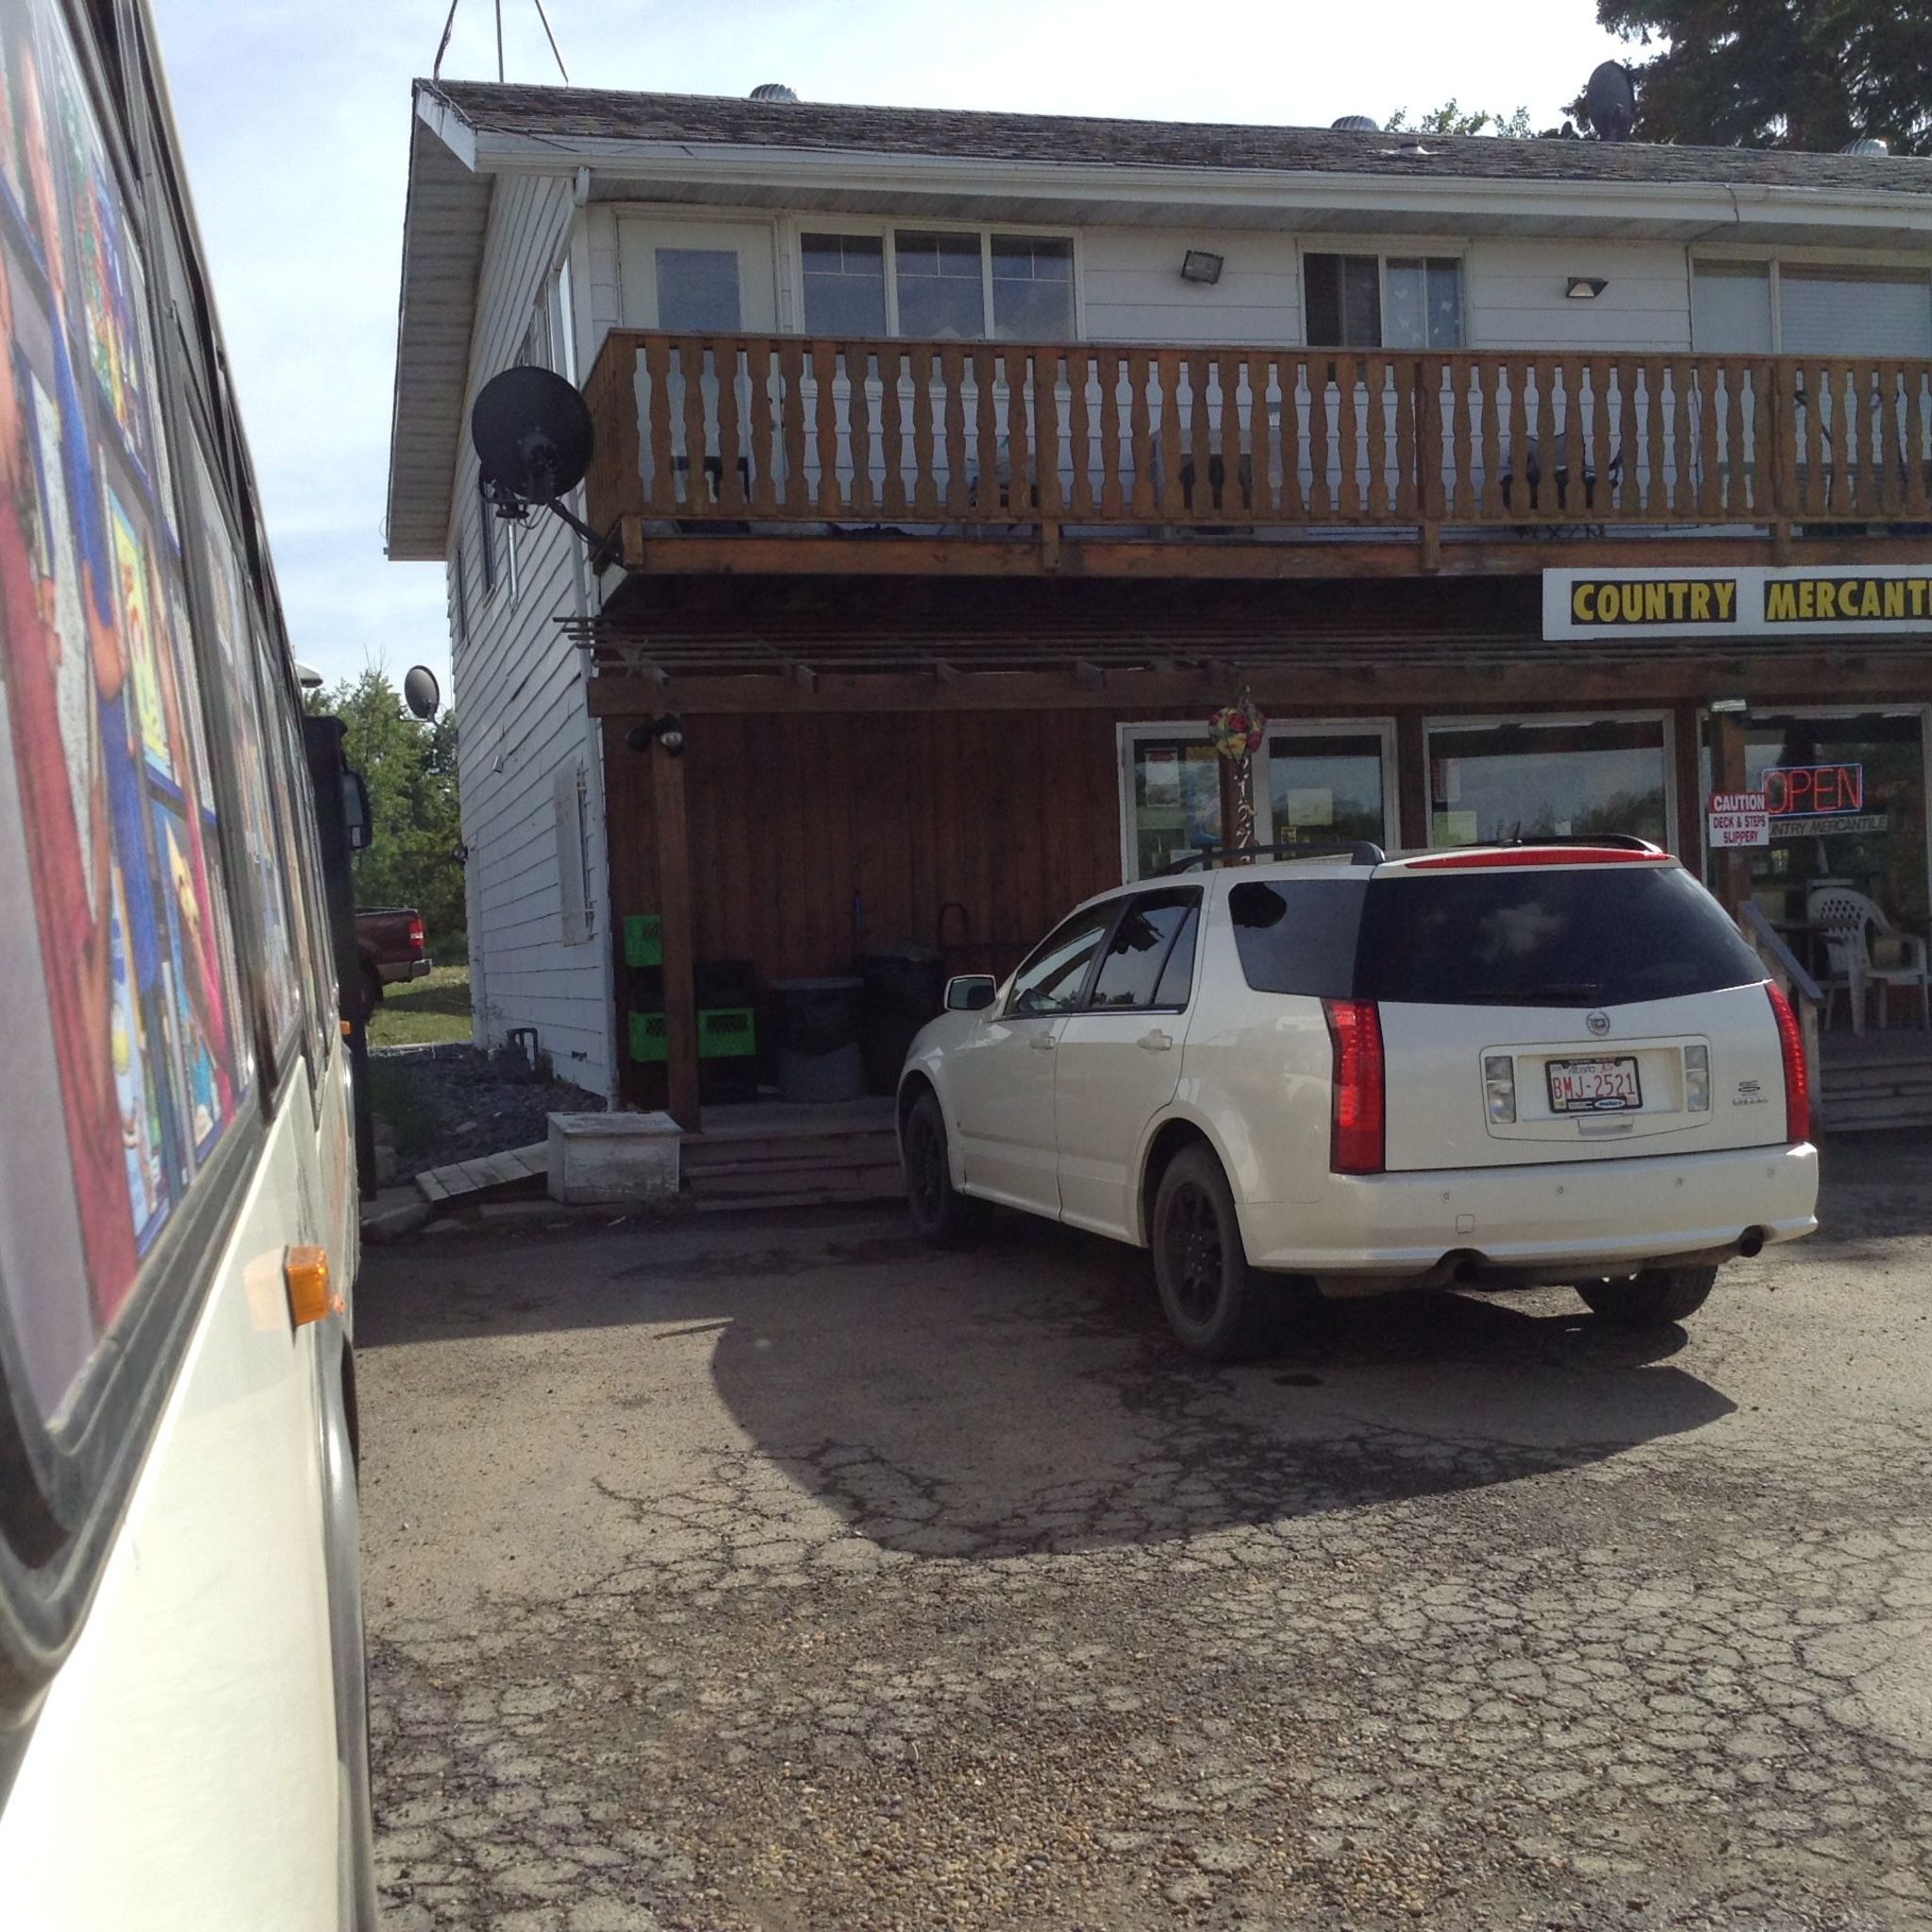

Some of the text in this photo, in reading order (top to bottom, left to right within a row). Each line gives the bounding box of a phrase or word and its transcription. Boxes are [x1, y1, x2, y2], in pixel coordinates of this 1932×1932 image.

[1573, 582, 1736, 622] COUNTRY
[1765, 767, 1860, 815] OPEN
[1713, 794, 1765, 811] CAUTION
[1713, 815, 1765, 828] DECK & STEPS
[1724, 830, 1758, 843] SLIPPERY
[1553, 1073, 1636, 1100] BMJ-2521
